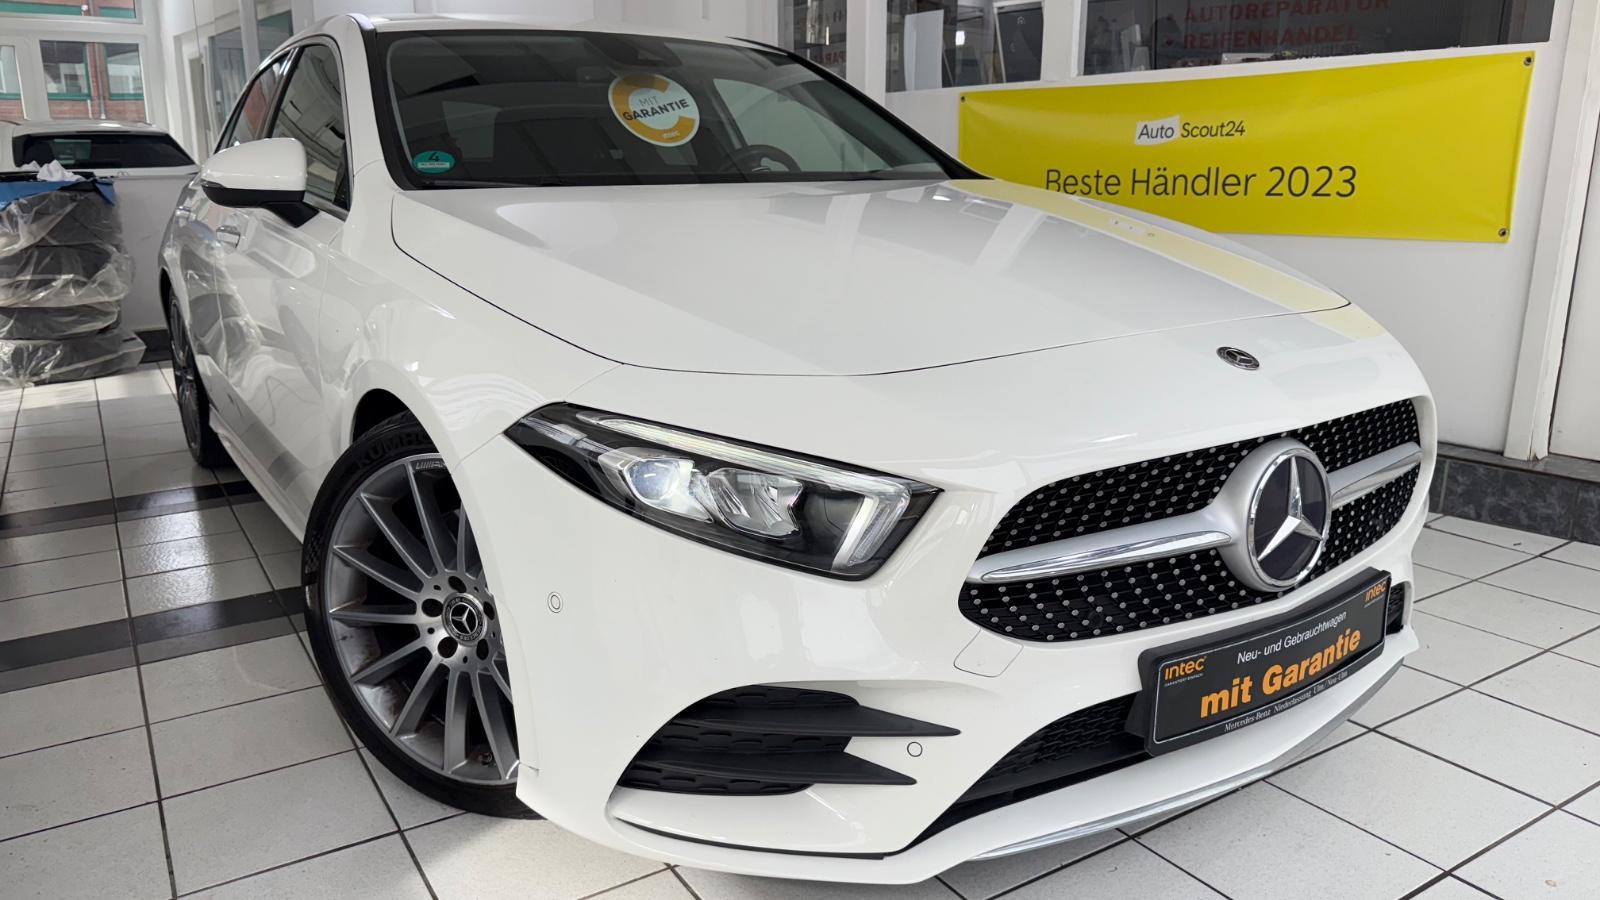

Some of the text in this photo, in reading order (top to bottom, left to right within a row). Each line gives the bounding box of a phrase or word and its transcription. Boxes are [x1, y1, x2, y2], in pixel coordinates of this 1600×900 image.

[1184, 25, 1360, 49] REIFENHANDEL
[622, 98, 690, 121] GARANTIE
[638, 96, 659, 107] MIT
[1138, 120, 1246, 139] Auto Scout24
[428, 151, 440, 162] 4
[1046, 165, 1358, 198] Beste Händler 2023
[1237, 611, 1347, 665] Neu- und Gebrauchtwagen
[1200, 627, 1361, 719] mit Garantie
[1224, 709, 1272, 732] Mercedes-Benz
[1273, 690, 1312, 713] Niederlassung
